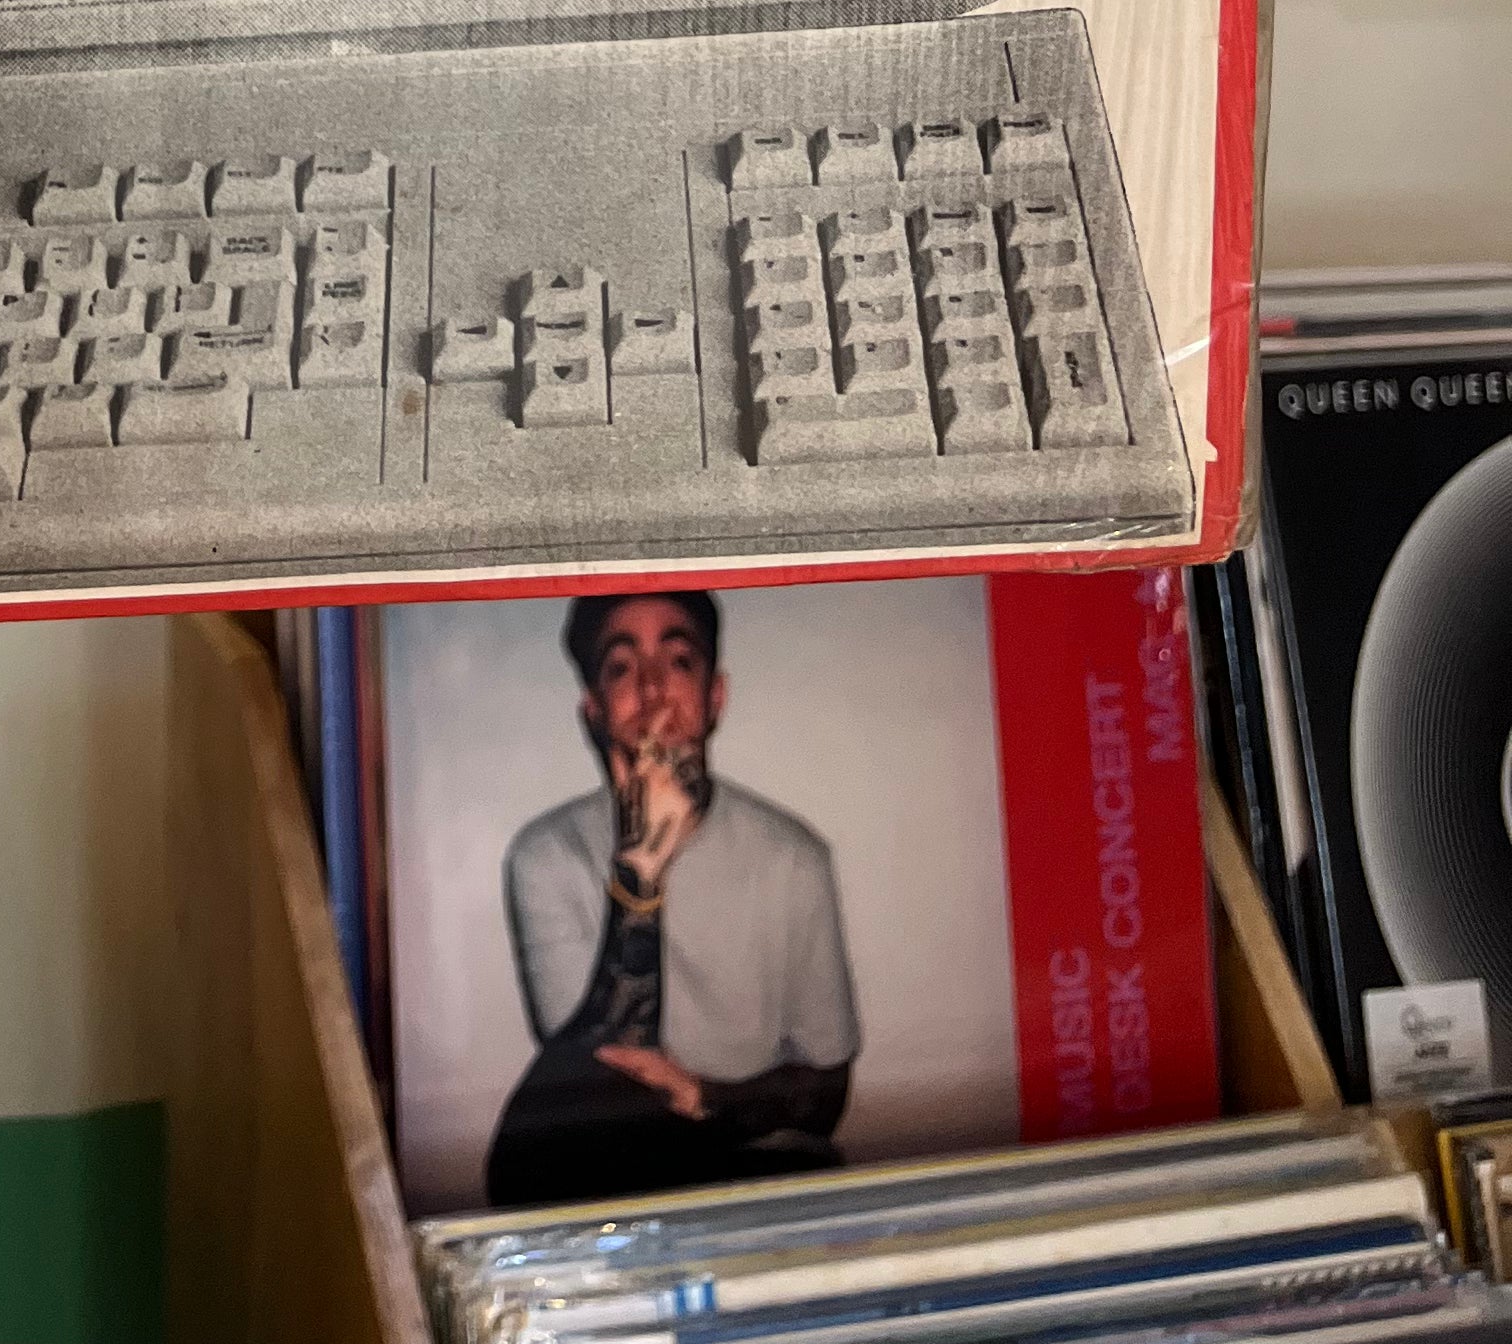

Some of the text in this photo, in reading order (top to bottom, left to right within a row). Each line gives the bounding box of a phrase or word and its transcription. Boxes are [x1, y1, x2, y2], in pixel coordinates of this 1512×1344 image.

[1277, 367, 1512, 421] QUEEN QUEE
[1084, 674, 1152, 1114] DESK CONCERT
[1048, 948, 1096, 1124] MUSIC
